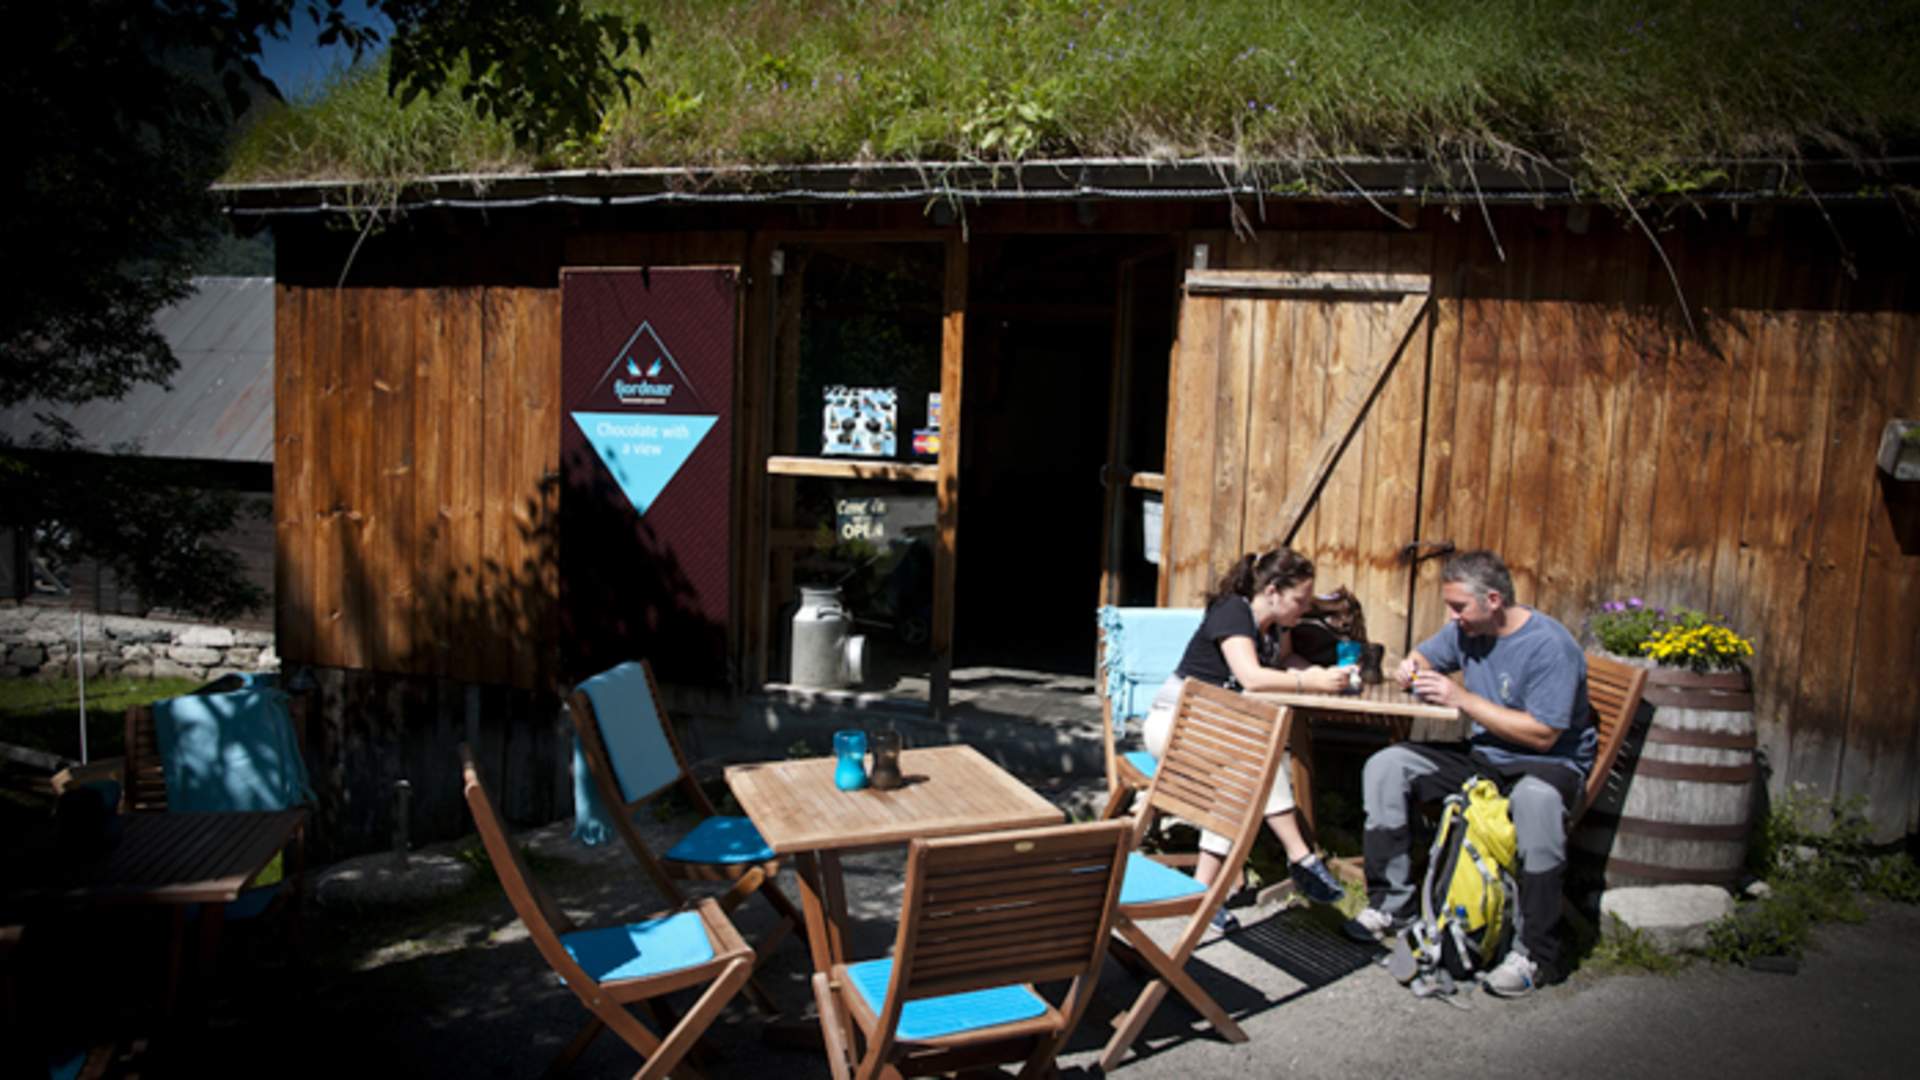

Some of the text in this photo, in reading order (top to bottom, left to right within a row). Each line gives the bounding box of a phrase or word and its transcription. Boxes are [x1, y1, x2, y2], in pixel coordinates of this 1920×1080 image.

[597, 422, 689, 438] Chocolate with
[634, 443, 662, 456] view
[842, 523, 884, 539] OPEN
